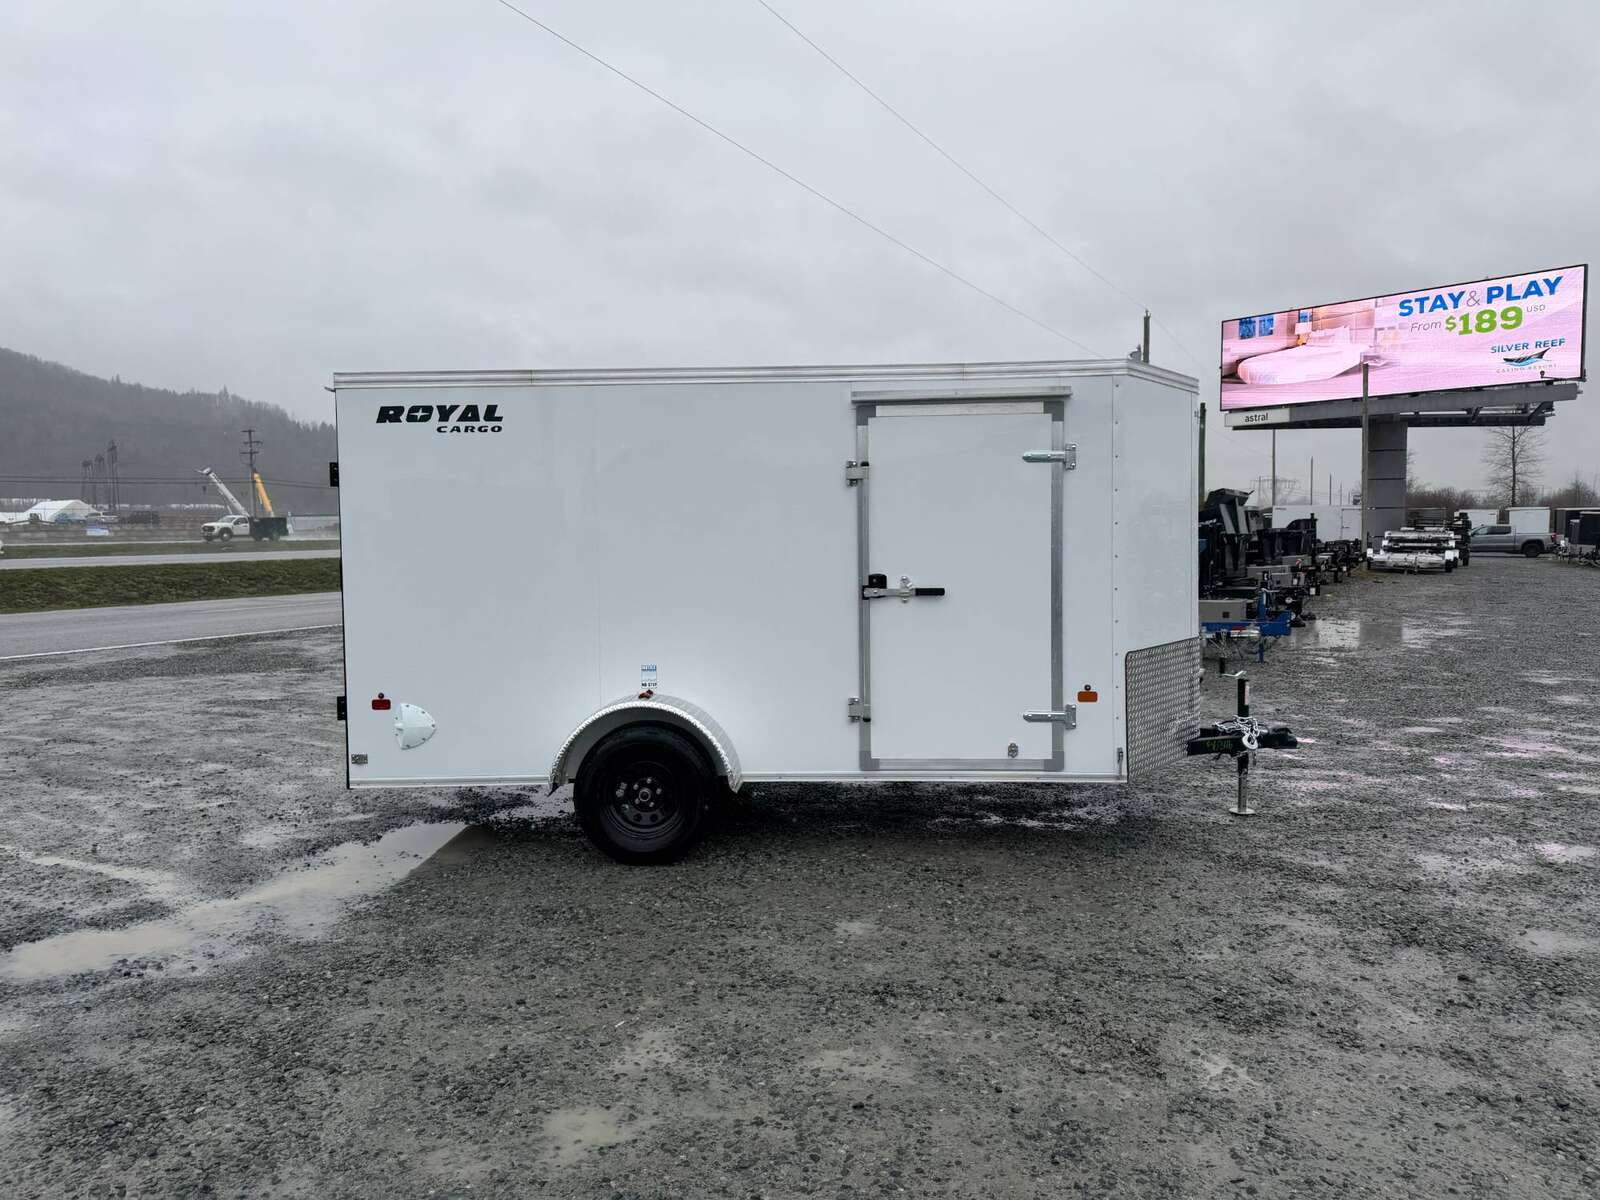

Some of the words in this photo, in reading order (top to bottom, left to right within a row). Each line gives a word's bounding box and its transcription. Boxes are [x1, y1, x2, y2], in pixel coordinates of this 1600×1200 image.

[1398, 290, 1465, 317] STAY
[1466, 290, 1481, 307] &
[1486, 275, 1564, 305] PLAY
[1410, 320, 1442, 333] From
[1444, 306, 1523, 335] $189
[1526, 304, 1546, 313] USD
[1490, 342, 1529, 354] SILVER
[1534, 338, 1566, 349] REEF
[376, 404, 504, 423] ROYAL
[1244, 412, 1269, 422] astral
[436, 425, 503, 433] CARGO
